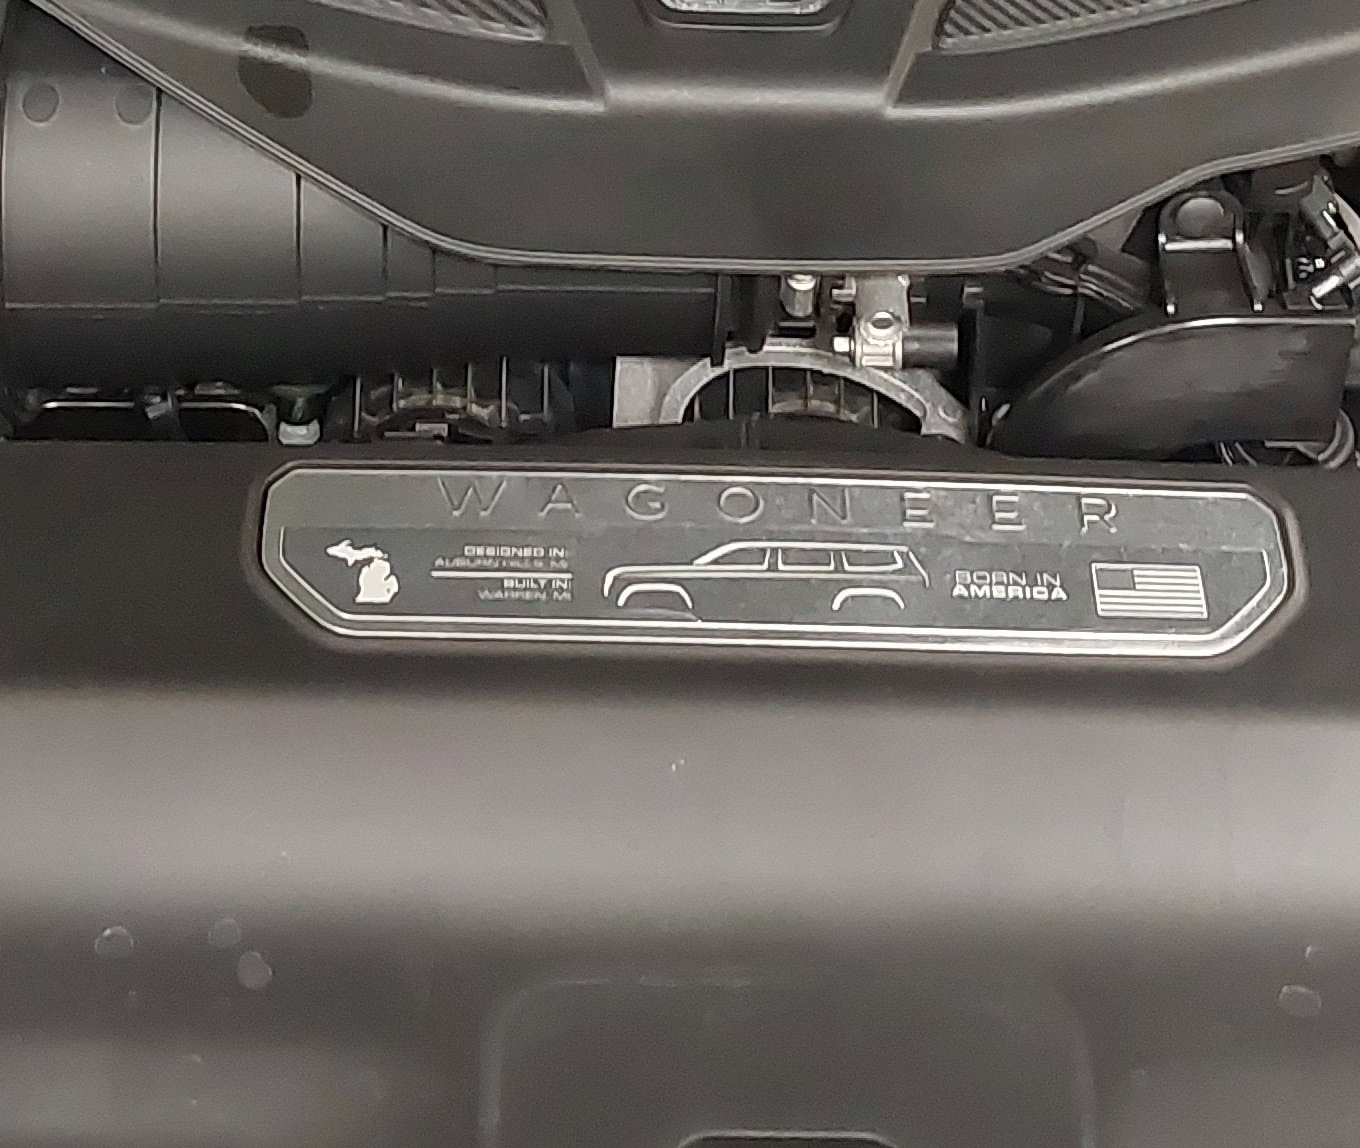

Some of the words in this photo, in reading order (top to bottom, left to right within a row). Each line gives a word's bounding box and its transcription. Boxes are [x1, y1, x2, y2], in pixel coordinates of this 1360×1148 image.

[436, 474, 1118, 536] WAGONEER
[463, 545, 545, 557] DESIGNED
[503, 578, 548, 590] BUILT
[955, 569, 1027, 586] BORN
[1036, 571, 1061, 587] IN
[951, 583, 1069, 602] AMERICA
